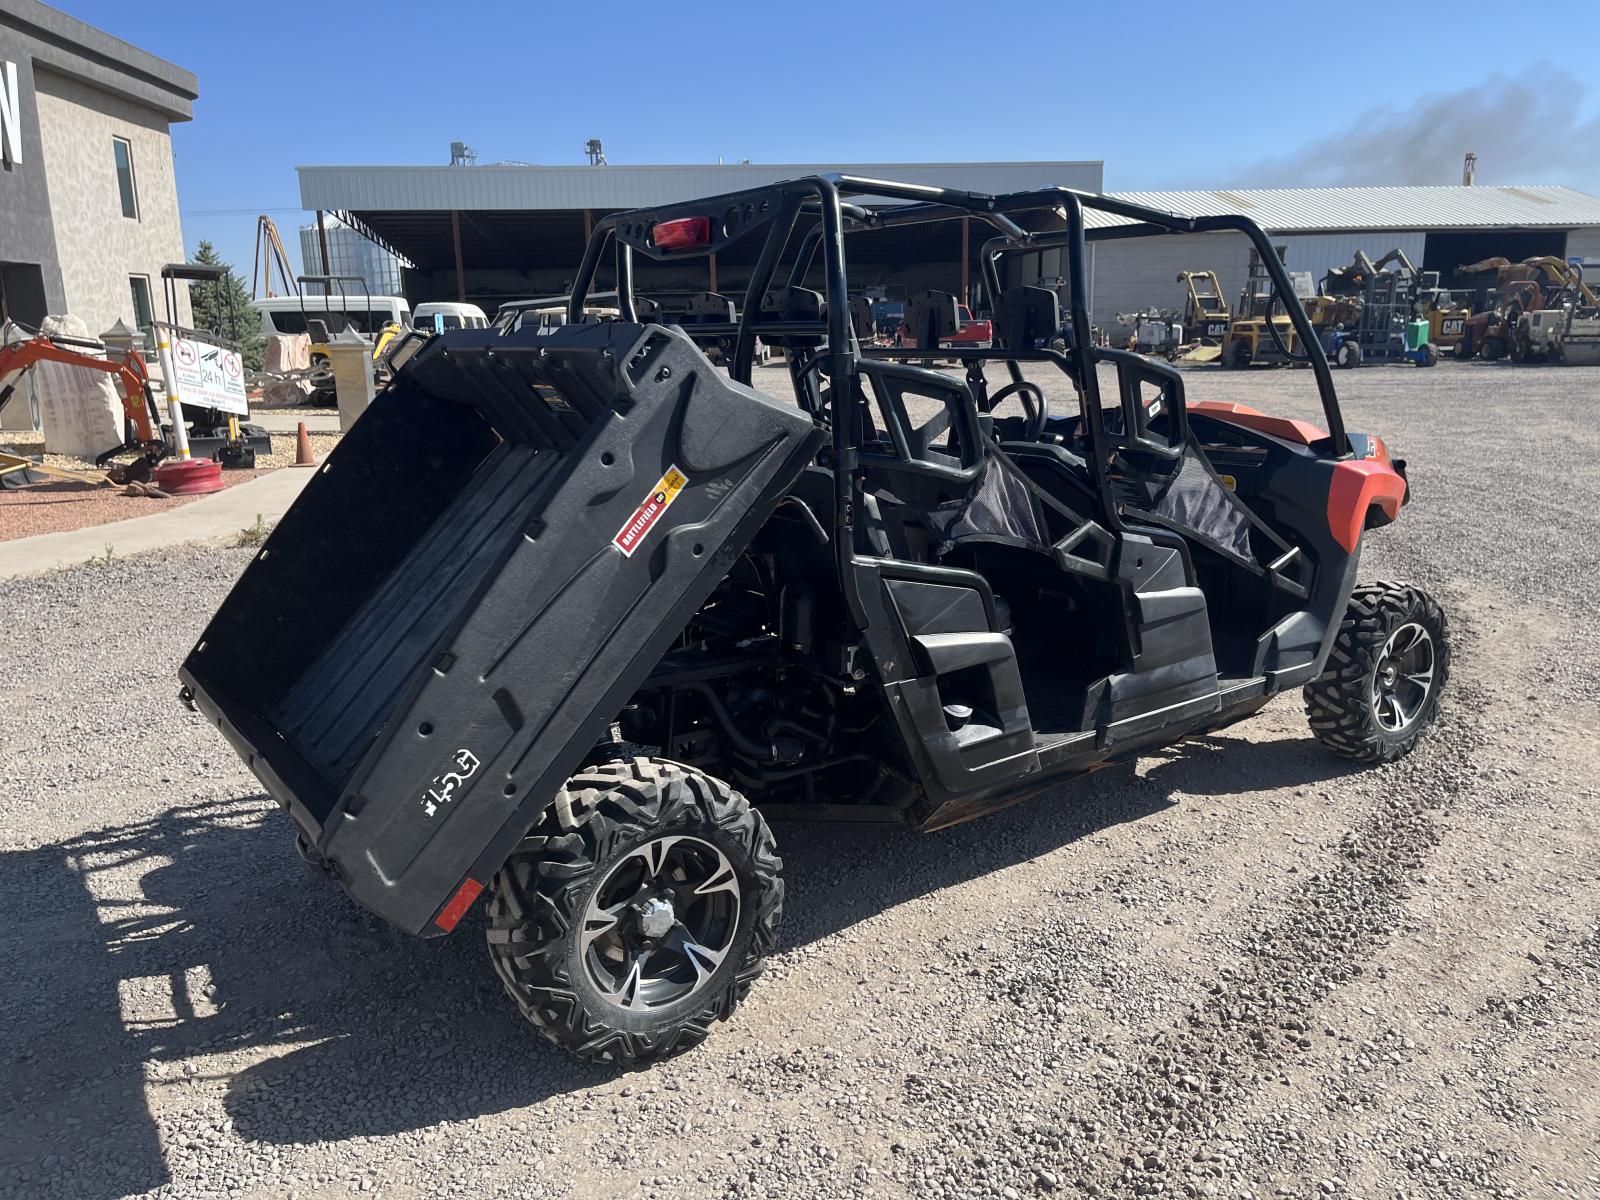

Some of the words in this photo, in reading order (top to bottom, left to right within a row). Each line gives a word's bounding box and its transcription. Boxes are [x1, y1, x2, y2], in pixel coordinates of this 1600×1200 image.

[1207, 324, 1226, 336] CAT
[1442, 319, 1464, 335] CAT
[202, 369, 213, 383] 24
[621, 502, 658, 546] BATTLEFIELD
